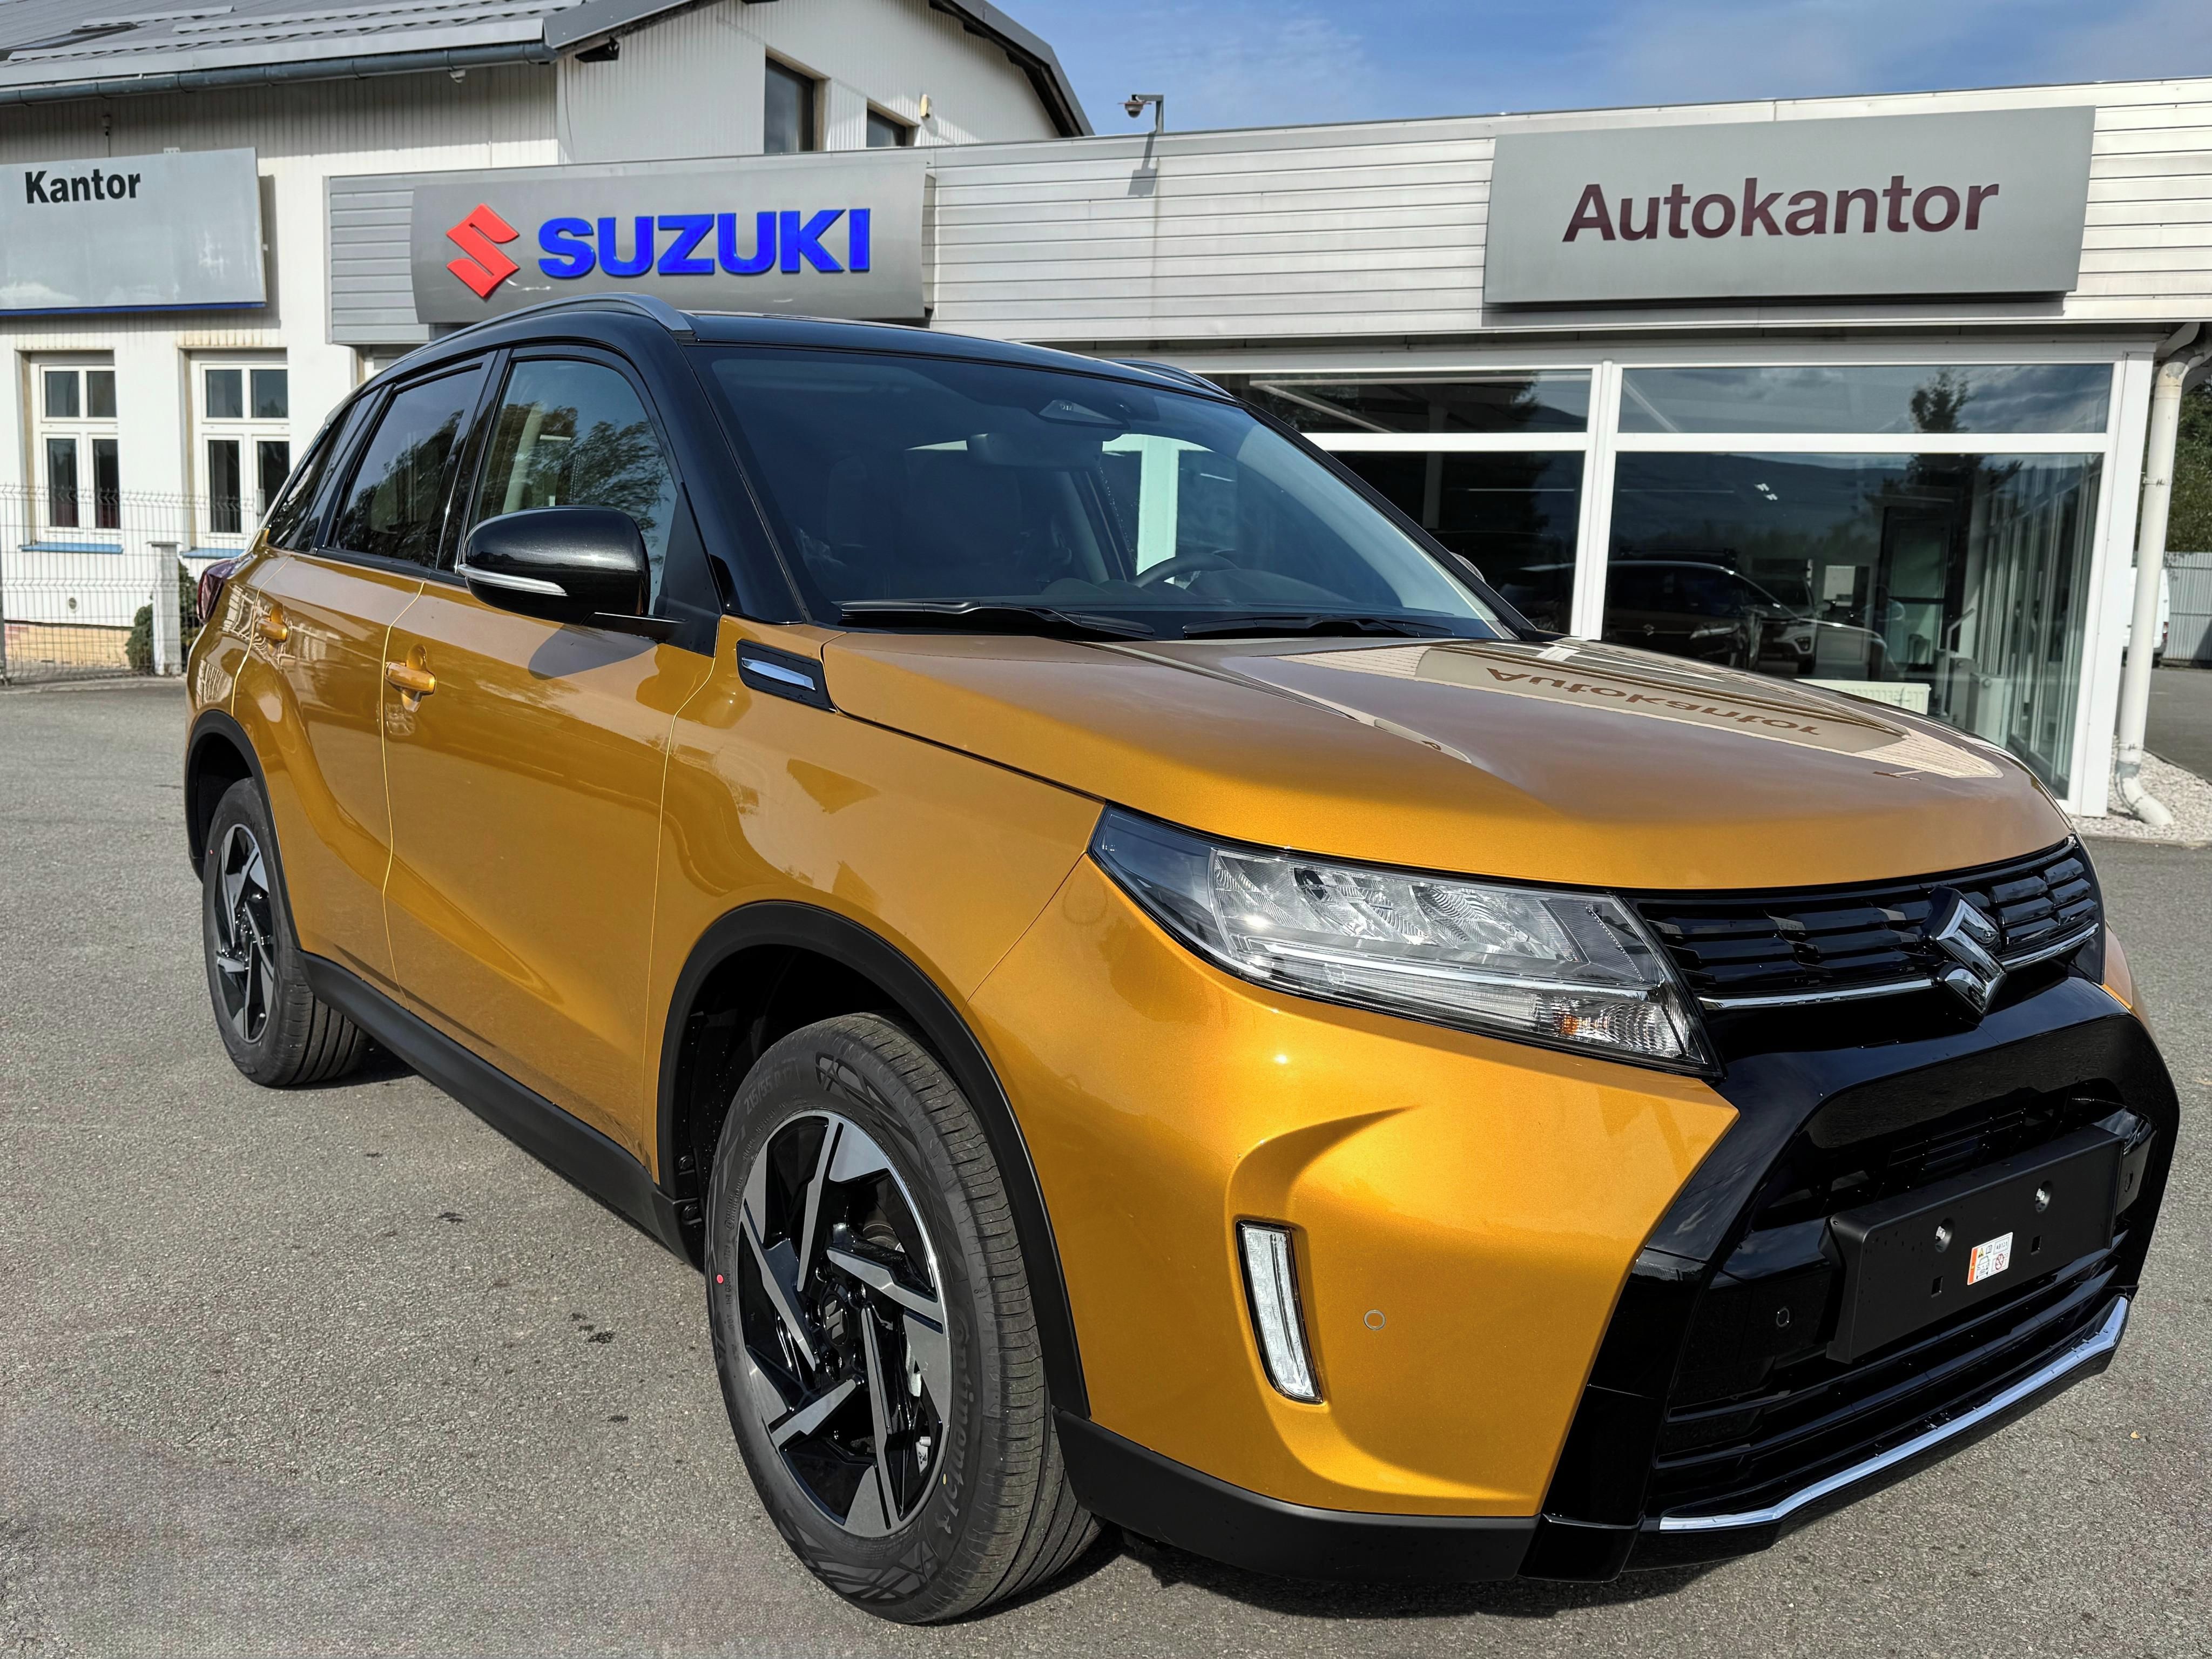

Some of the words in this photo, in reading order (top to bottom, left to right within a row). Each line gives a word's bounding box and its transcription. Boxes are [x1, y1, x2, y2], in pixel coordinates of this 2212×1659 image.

[25, 168, 141, 204] Kantor
[1562, 174, 2000, 242] Autokantor
[537, 208, 871, 279] SUZUKI
[949, 1311, 974, 1518] Continental
